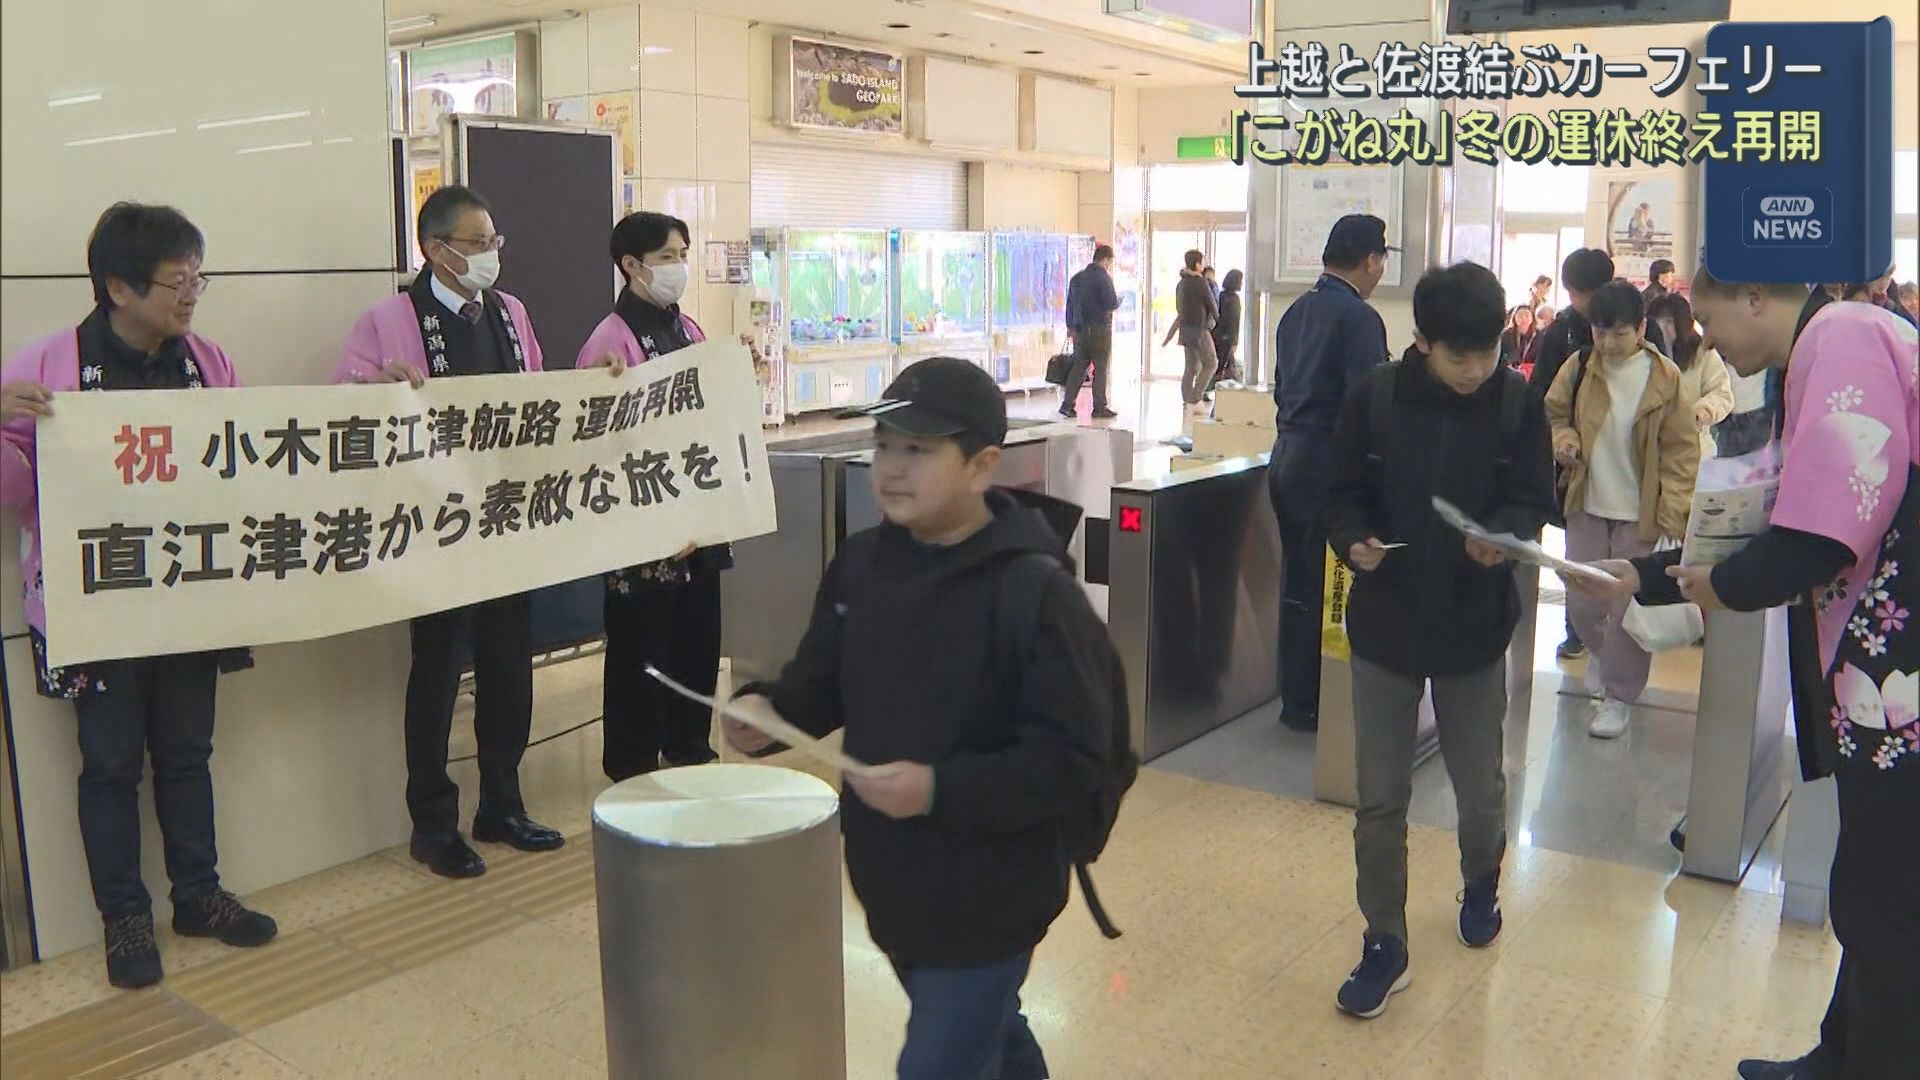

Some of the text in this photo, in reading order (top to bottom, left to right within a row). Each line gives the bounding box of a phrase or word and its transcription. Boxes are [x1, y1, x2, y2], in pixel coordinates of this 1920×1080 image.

[796, 69, 831, 82] Welcome
[841, 72, 866, 86] SADO
[867, 78, 899, 90] ISLAND
[856, 89, 899, 104] GEOPARK
[423, 314, 449, 373] 新潟県
[113, 366, 706, 486] 祝 小木直江津航路 運航再開
[77, 432, 752, 595] 直江津港から素敵な旅を！
